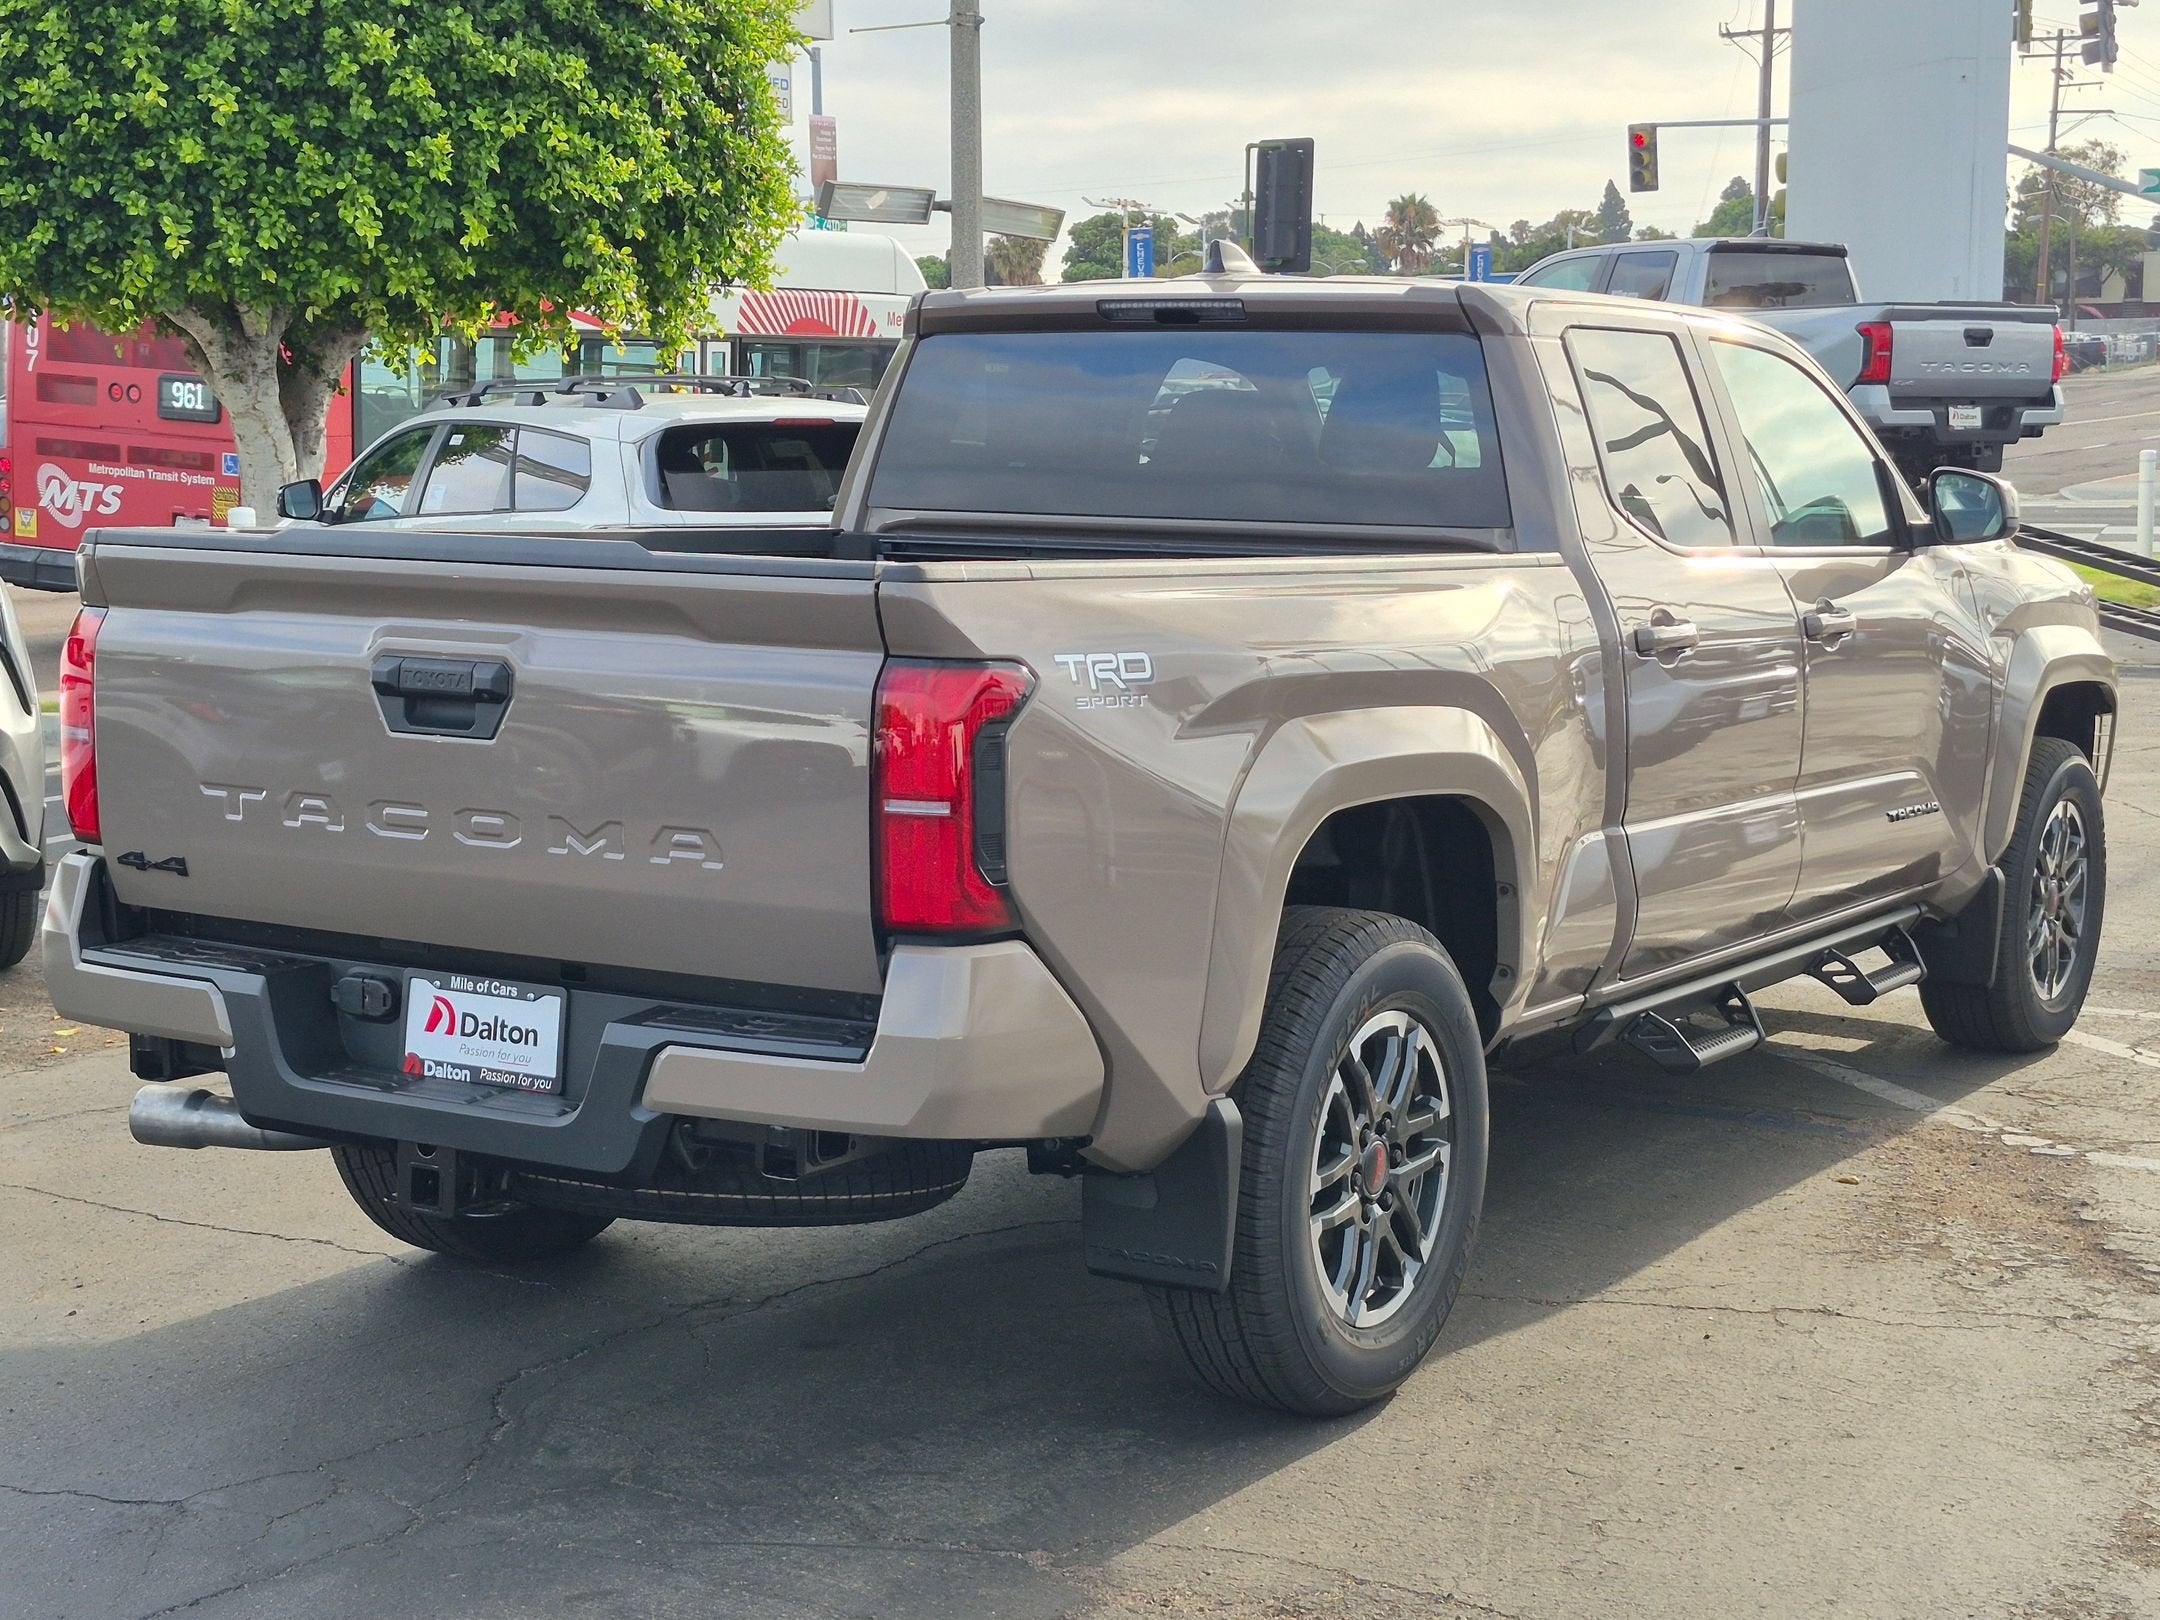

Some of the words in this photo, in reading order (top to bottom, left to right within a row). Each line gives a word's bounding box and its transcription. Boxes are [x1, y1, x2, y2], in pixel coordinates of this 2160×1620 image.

[887, 311, 904, 327] Me
[26, 309, 39, 371] 07
[1920, 362, 2030, 373] TACOMA
[171, 381, 204, 410] 961
[89, 463, 145, 478] Metropolitan
[147, 468, 179, 482] Transit
[181, 472, 215, 485] System
[38, 479, 125, 515] MTS
[403, 670, 466, 689] TOYOTA
[1053, 651, 1152, 690] TRD
[1076, 694, 1149, 709] SPORT
[199, 783, 725, 871] TACOMA
[450, 976, 474, 992] Mile
[476, 981, 490, 993] of
[491, 982, 518, 998] Cars
[460, 1011, 539, 1047] Dalton
[459, 1043, 495, 1059] Passion
[497, 1048, 511, 1061] for
[513, 1052, 532, 1064] you
[423, 1060, 471, 1083] Dalton
[479, 1068, 516, 1085] Passion
[517, 1073, 533, 1087] for
[533, 1078, 553, 1090] you
